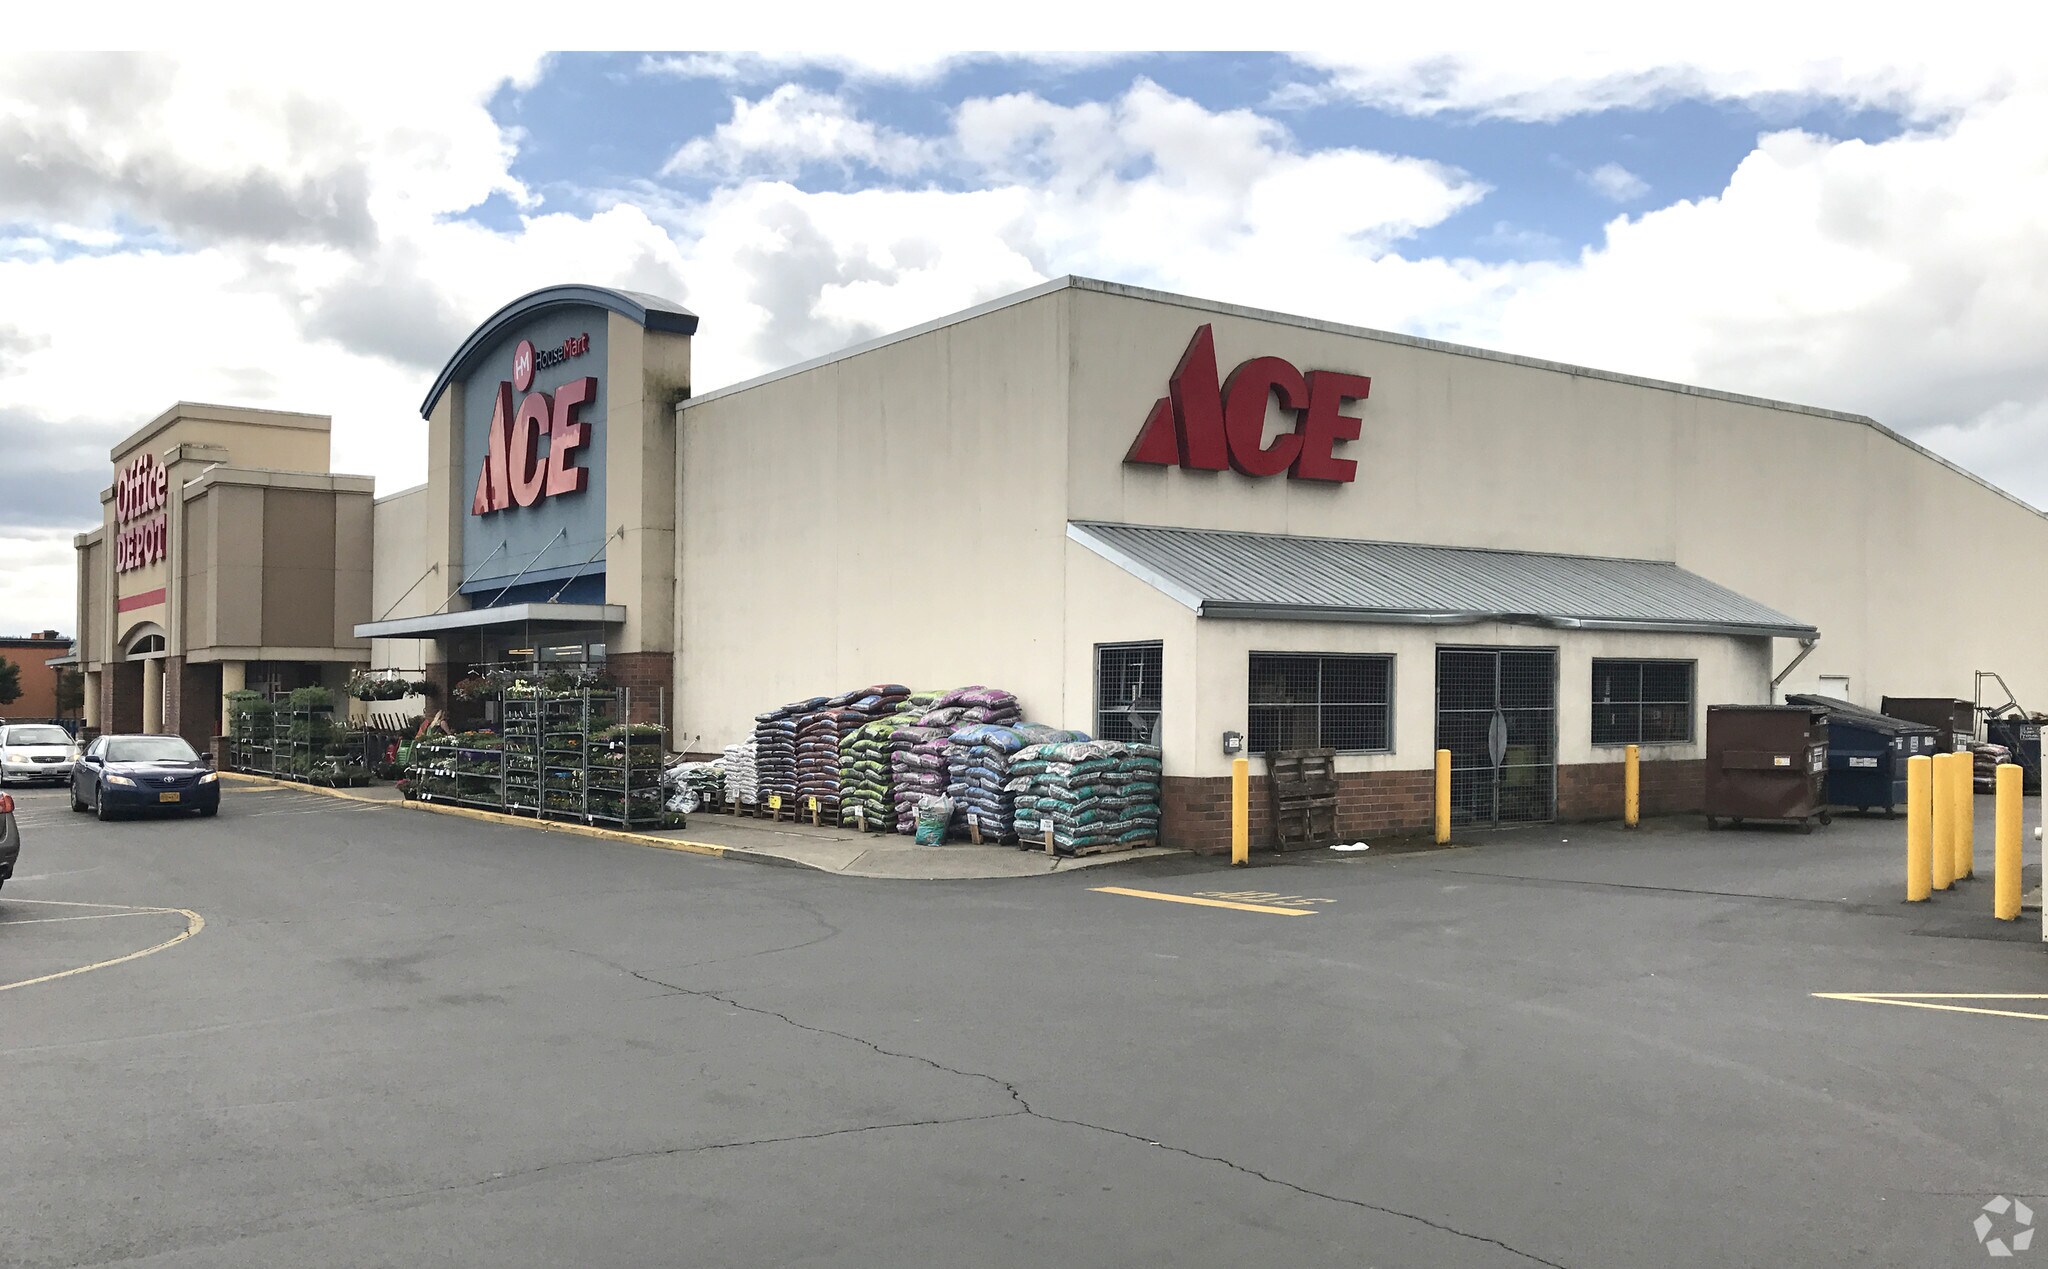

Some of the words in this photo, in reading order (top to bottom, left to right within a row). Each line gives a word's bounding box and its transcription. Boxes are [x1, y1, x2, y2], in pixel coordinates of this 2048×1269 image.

[515, 351, 530, 380] HM
[536, 333, 590, 371] HouseMart
[1122, 323, 1372, 484] ACE
[472, 376, 598, 516] ACE
[117, 454, 168, 524] Office
[116, 514, 167, 573] DEPOT
